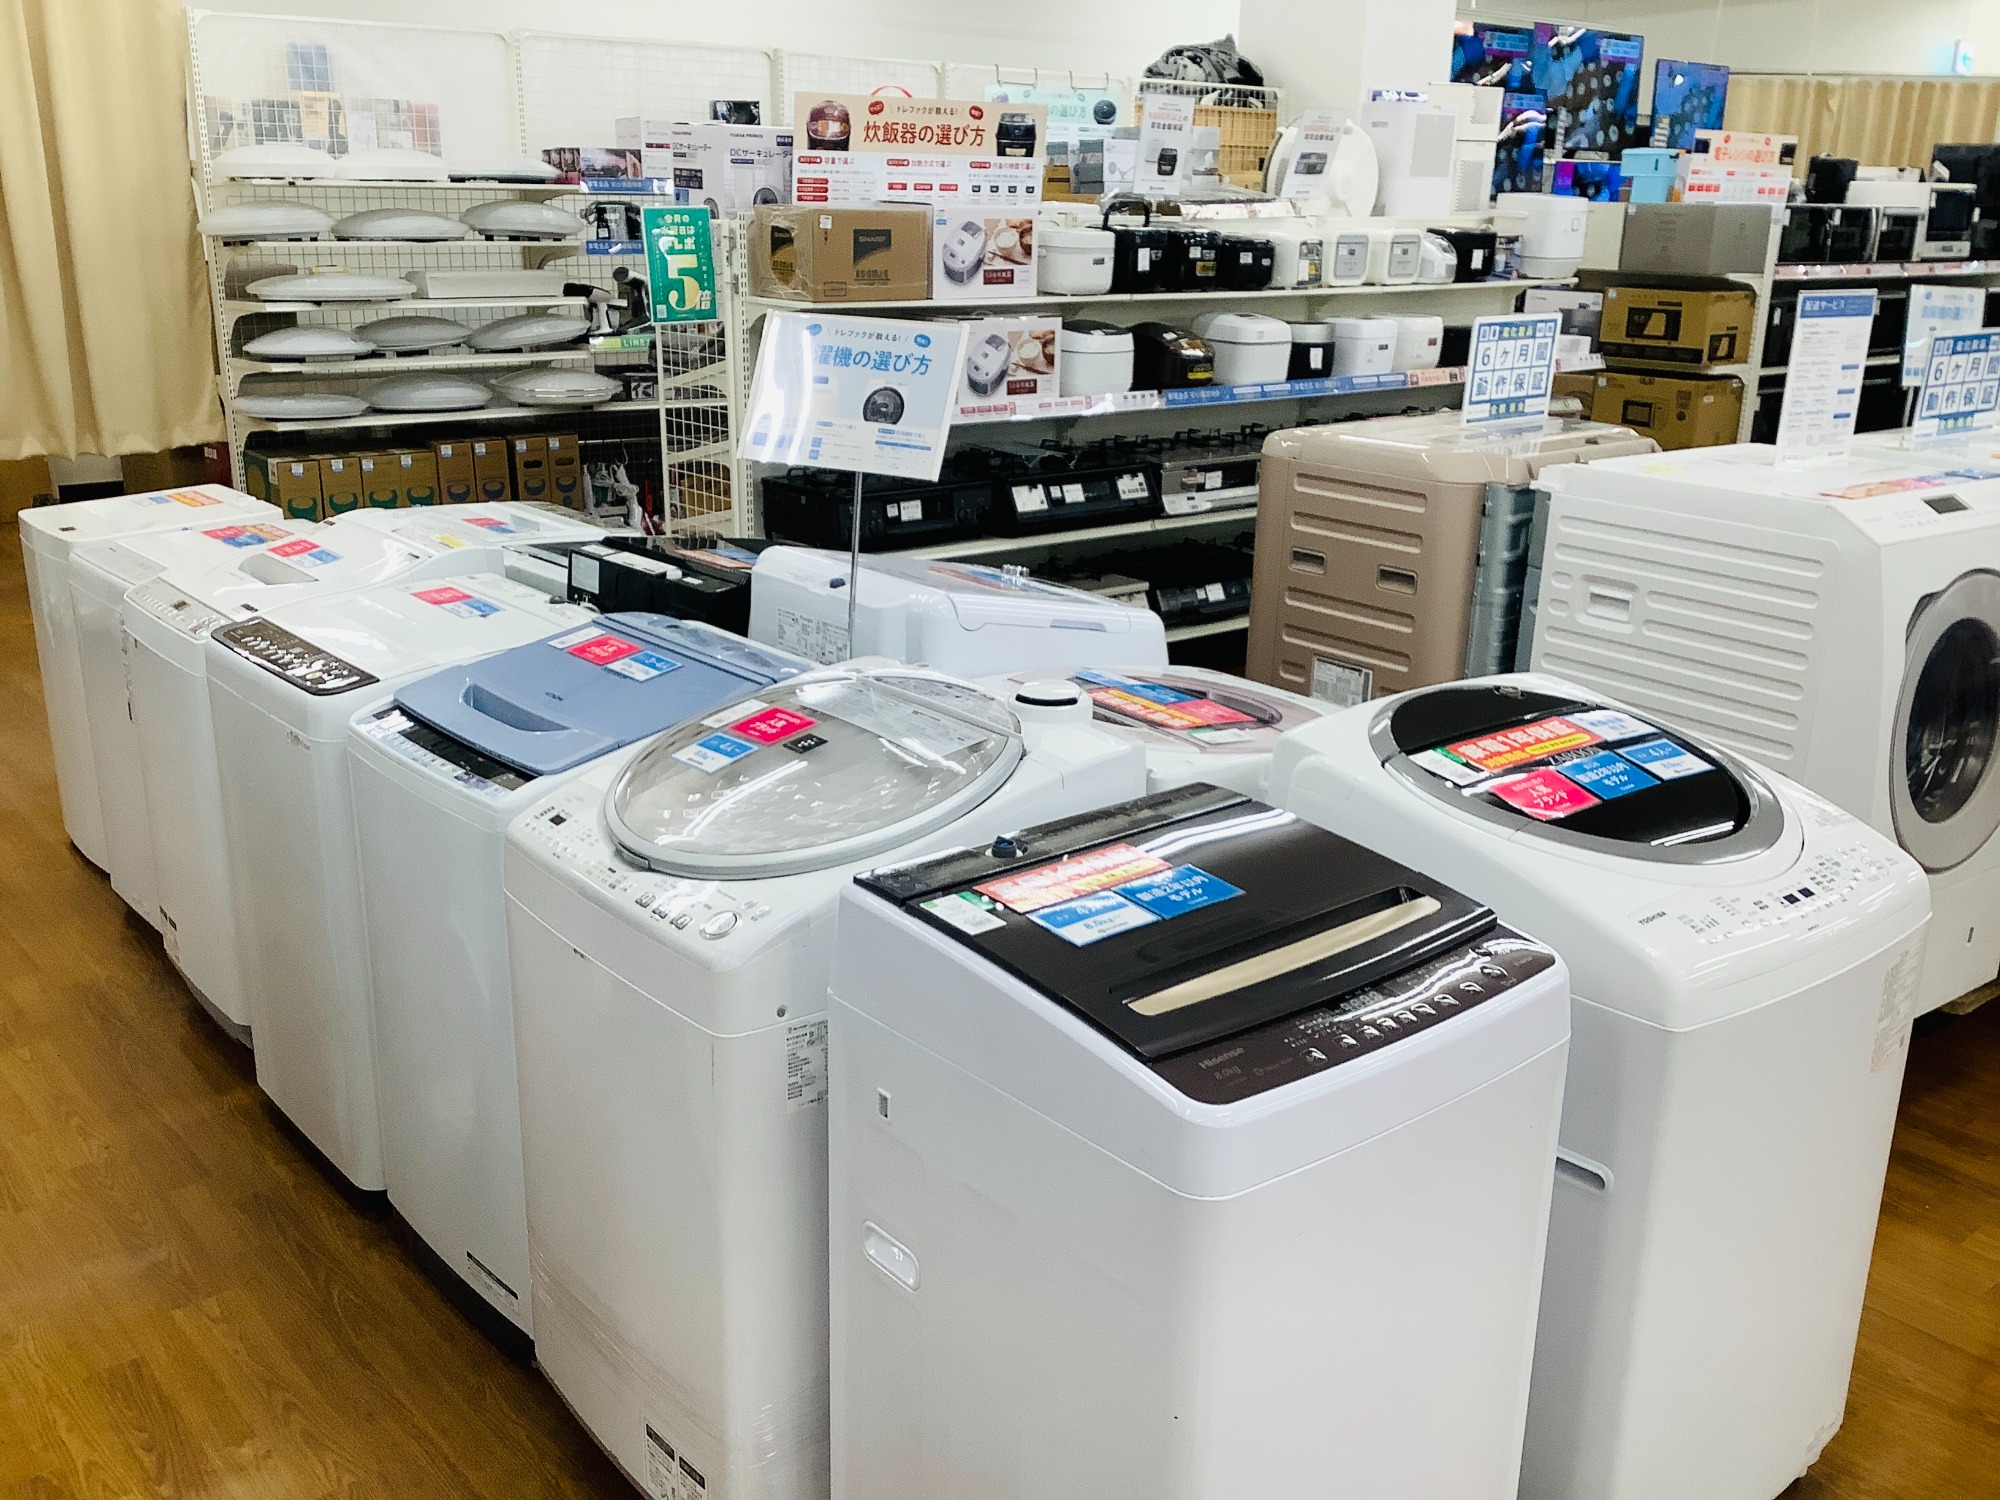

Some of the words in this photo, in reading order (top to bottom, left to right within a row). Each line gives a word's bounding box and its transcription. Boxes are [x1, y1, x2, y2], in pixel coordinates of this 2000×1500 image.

[863, 119, 986, 147] 炊飯器の選び方
[729, 148, 793, 159] DCサーキュレーター
[858, 235, 886, 243] SHARP
[808, 343, 933, 376] 濯機の選び方
[1602, 775, 1630, 787] モデル
[1529, 784, 1553, 799] 人気
[1533, 790, 1568, 808] ブランド
[1168, 887, 1204, 903] モデル
